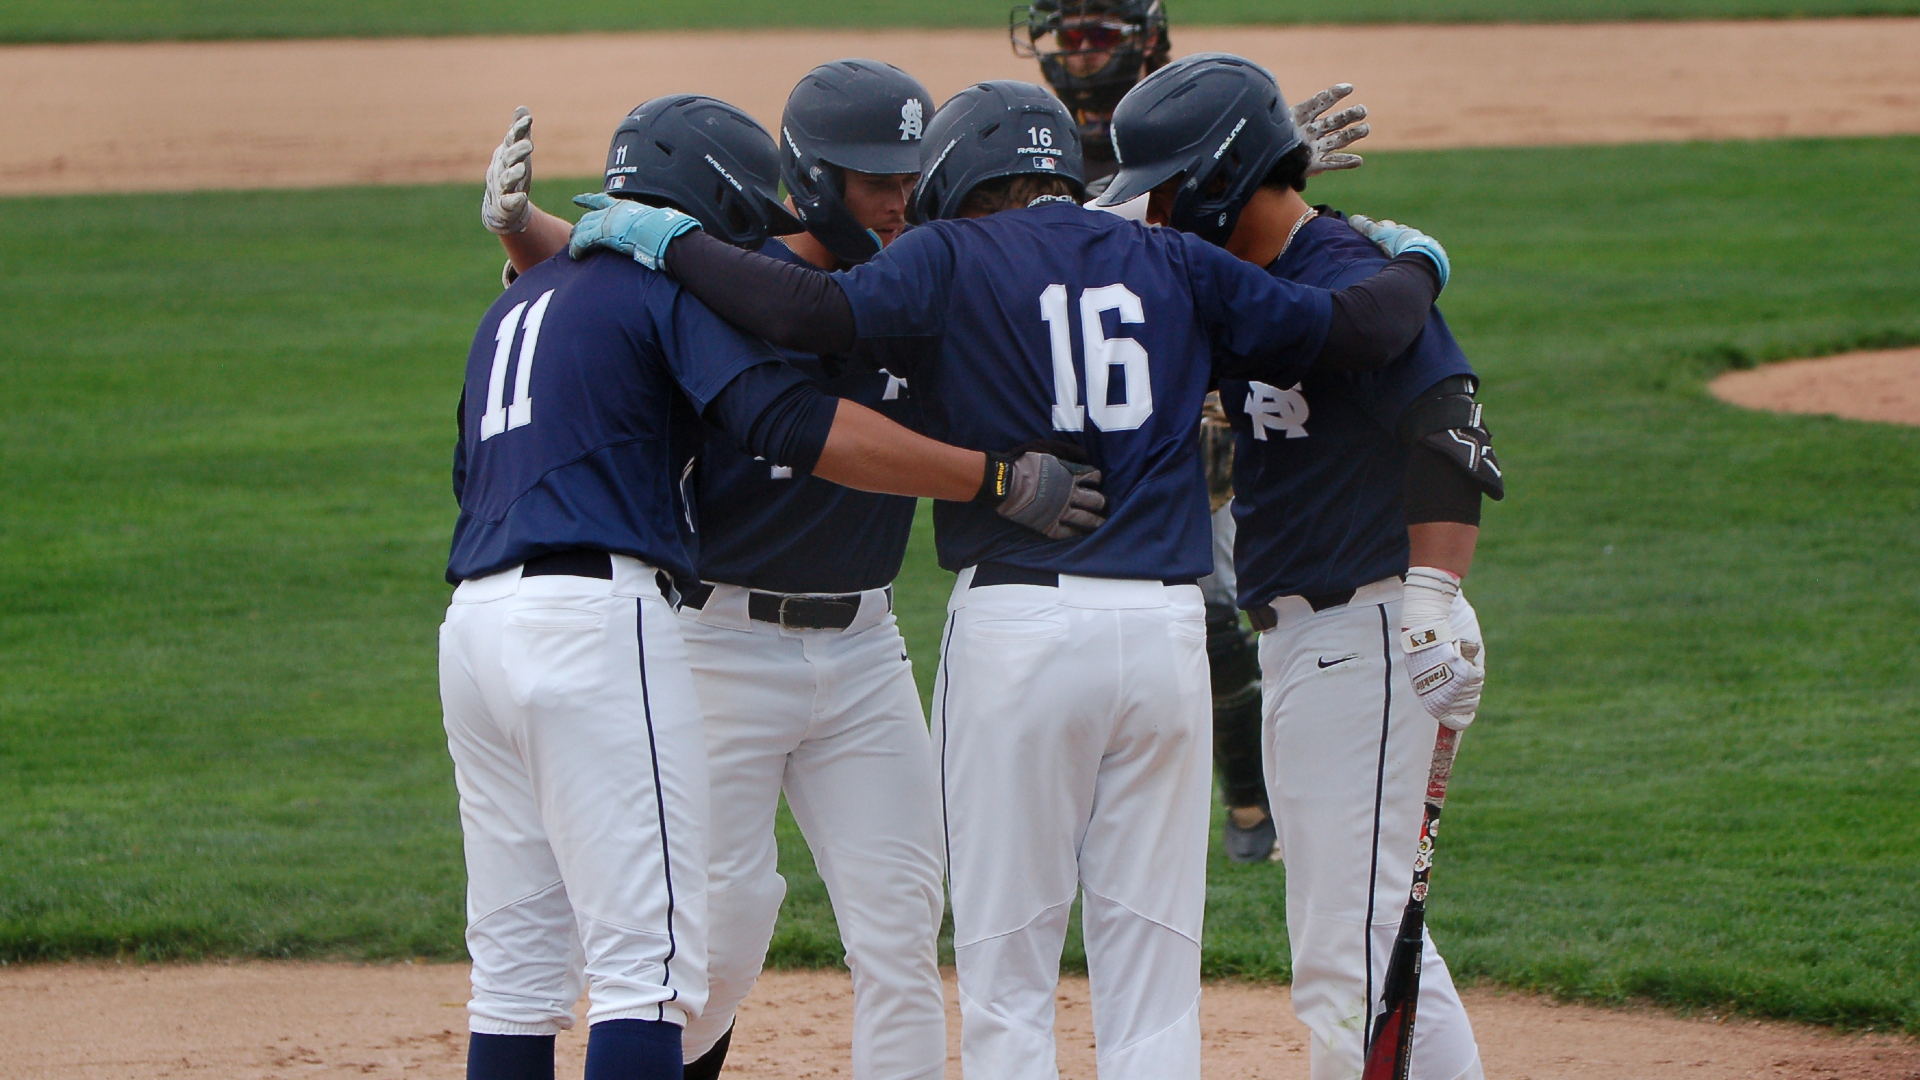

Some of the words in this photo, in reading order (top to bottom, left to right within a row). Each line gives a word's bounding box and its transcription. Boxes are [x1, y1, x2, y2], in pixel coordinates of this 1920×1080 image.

[1028, 126, 1053, 147] 16
[615, 144, 628, 165] 11
[1017, 147, 1063, 156] RAWLINGS
[705, 154, 743, 191] RAWLINGS
[480, 288, 555, 442] 11
[1039, 283, 1153, 432] 16
